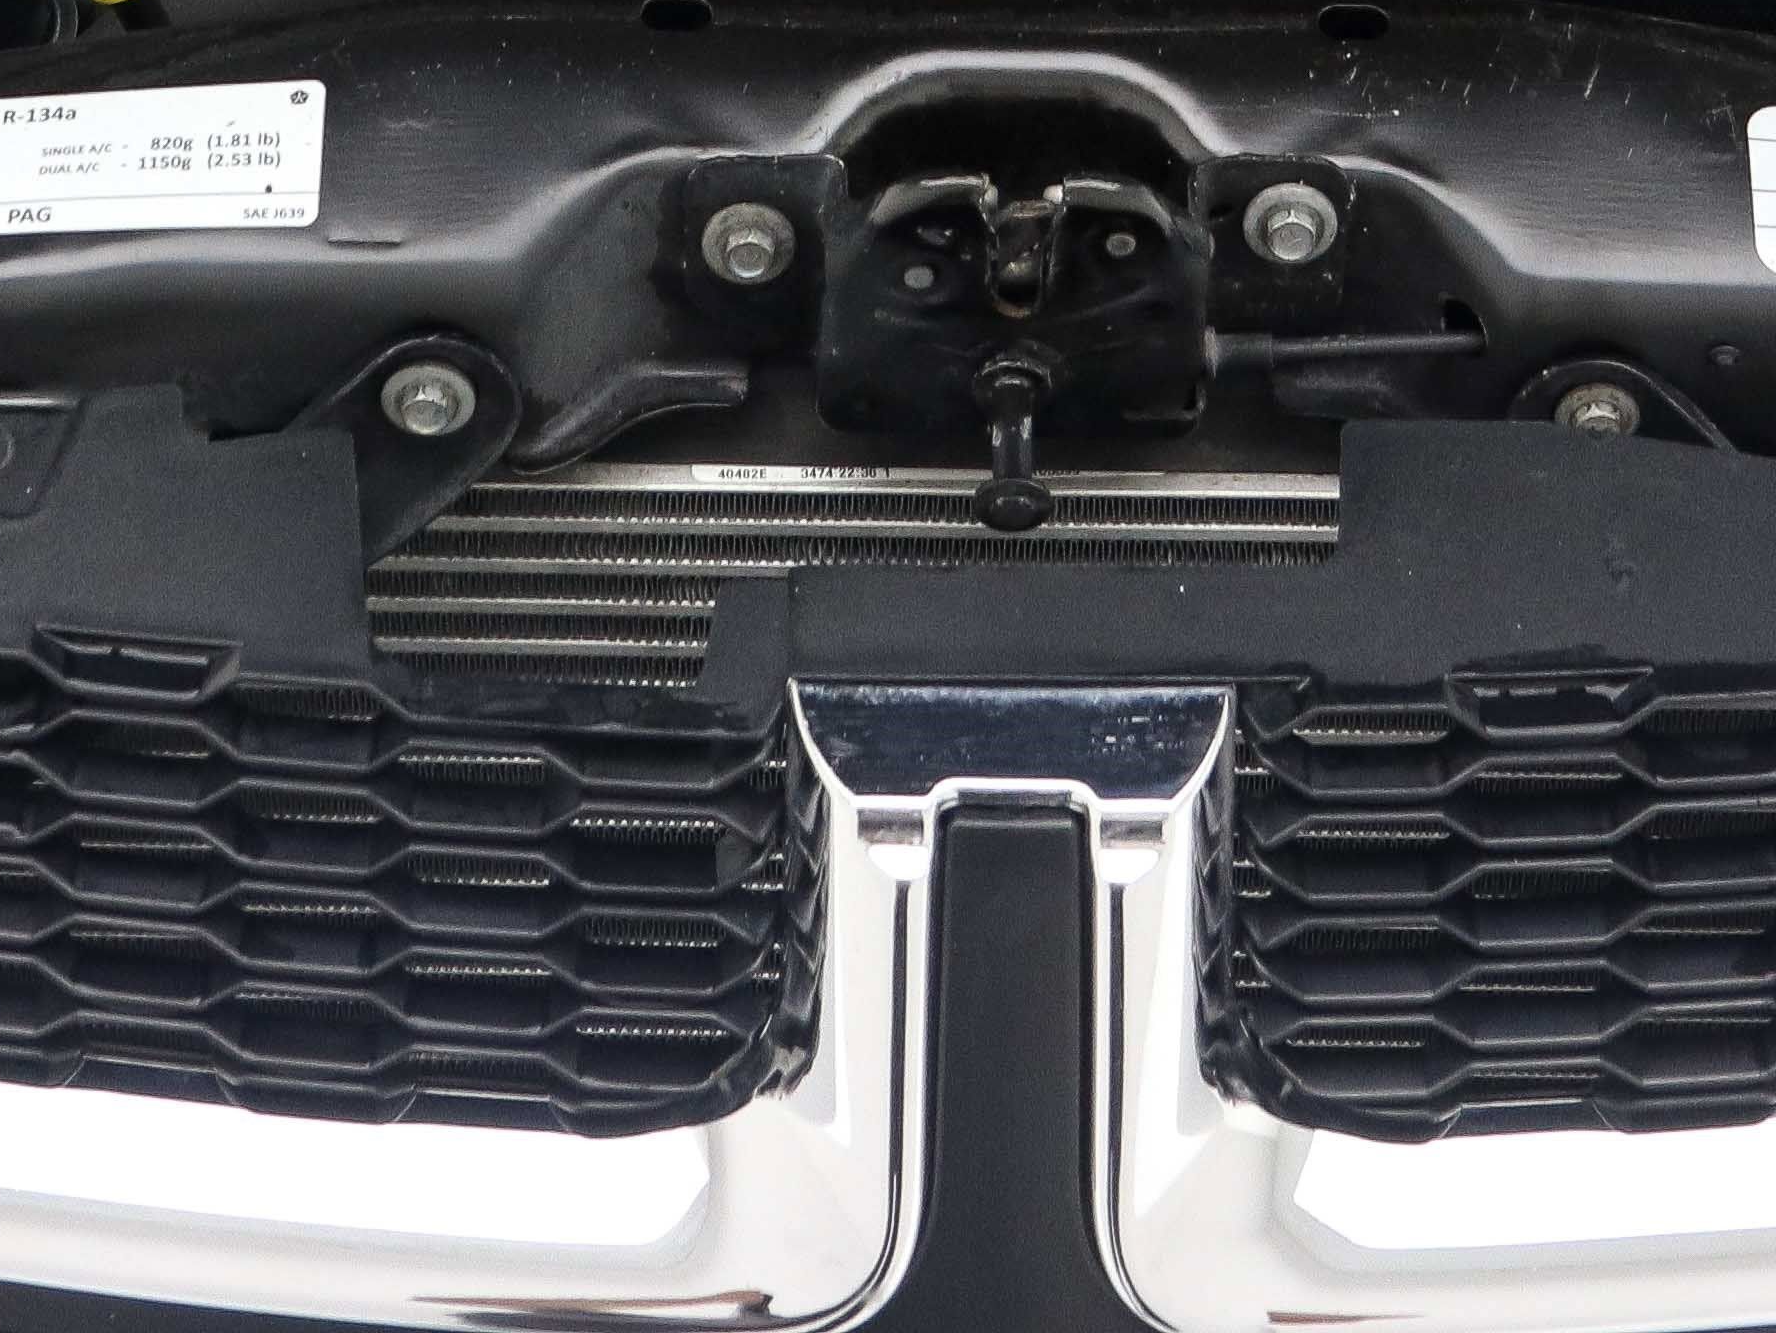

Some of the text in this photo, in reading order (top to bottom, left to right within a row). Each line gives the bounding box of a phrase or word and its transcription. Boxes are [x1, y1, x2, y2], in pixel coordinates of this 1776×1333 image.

[3, 107, 77, 125] R-134a
[42, 132, 281, 157] SINGLE A/C 820g (1.81 lb)
[39, 152, 281, 176] DUAL A/C 1150g (2.53 lb)
[7, 207, 52, 223] PAG
[243, 208, 271, 220] SAE
